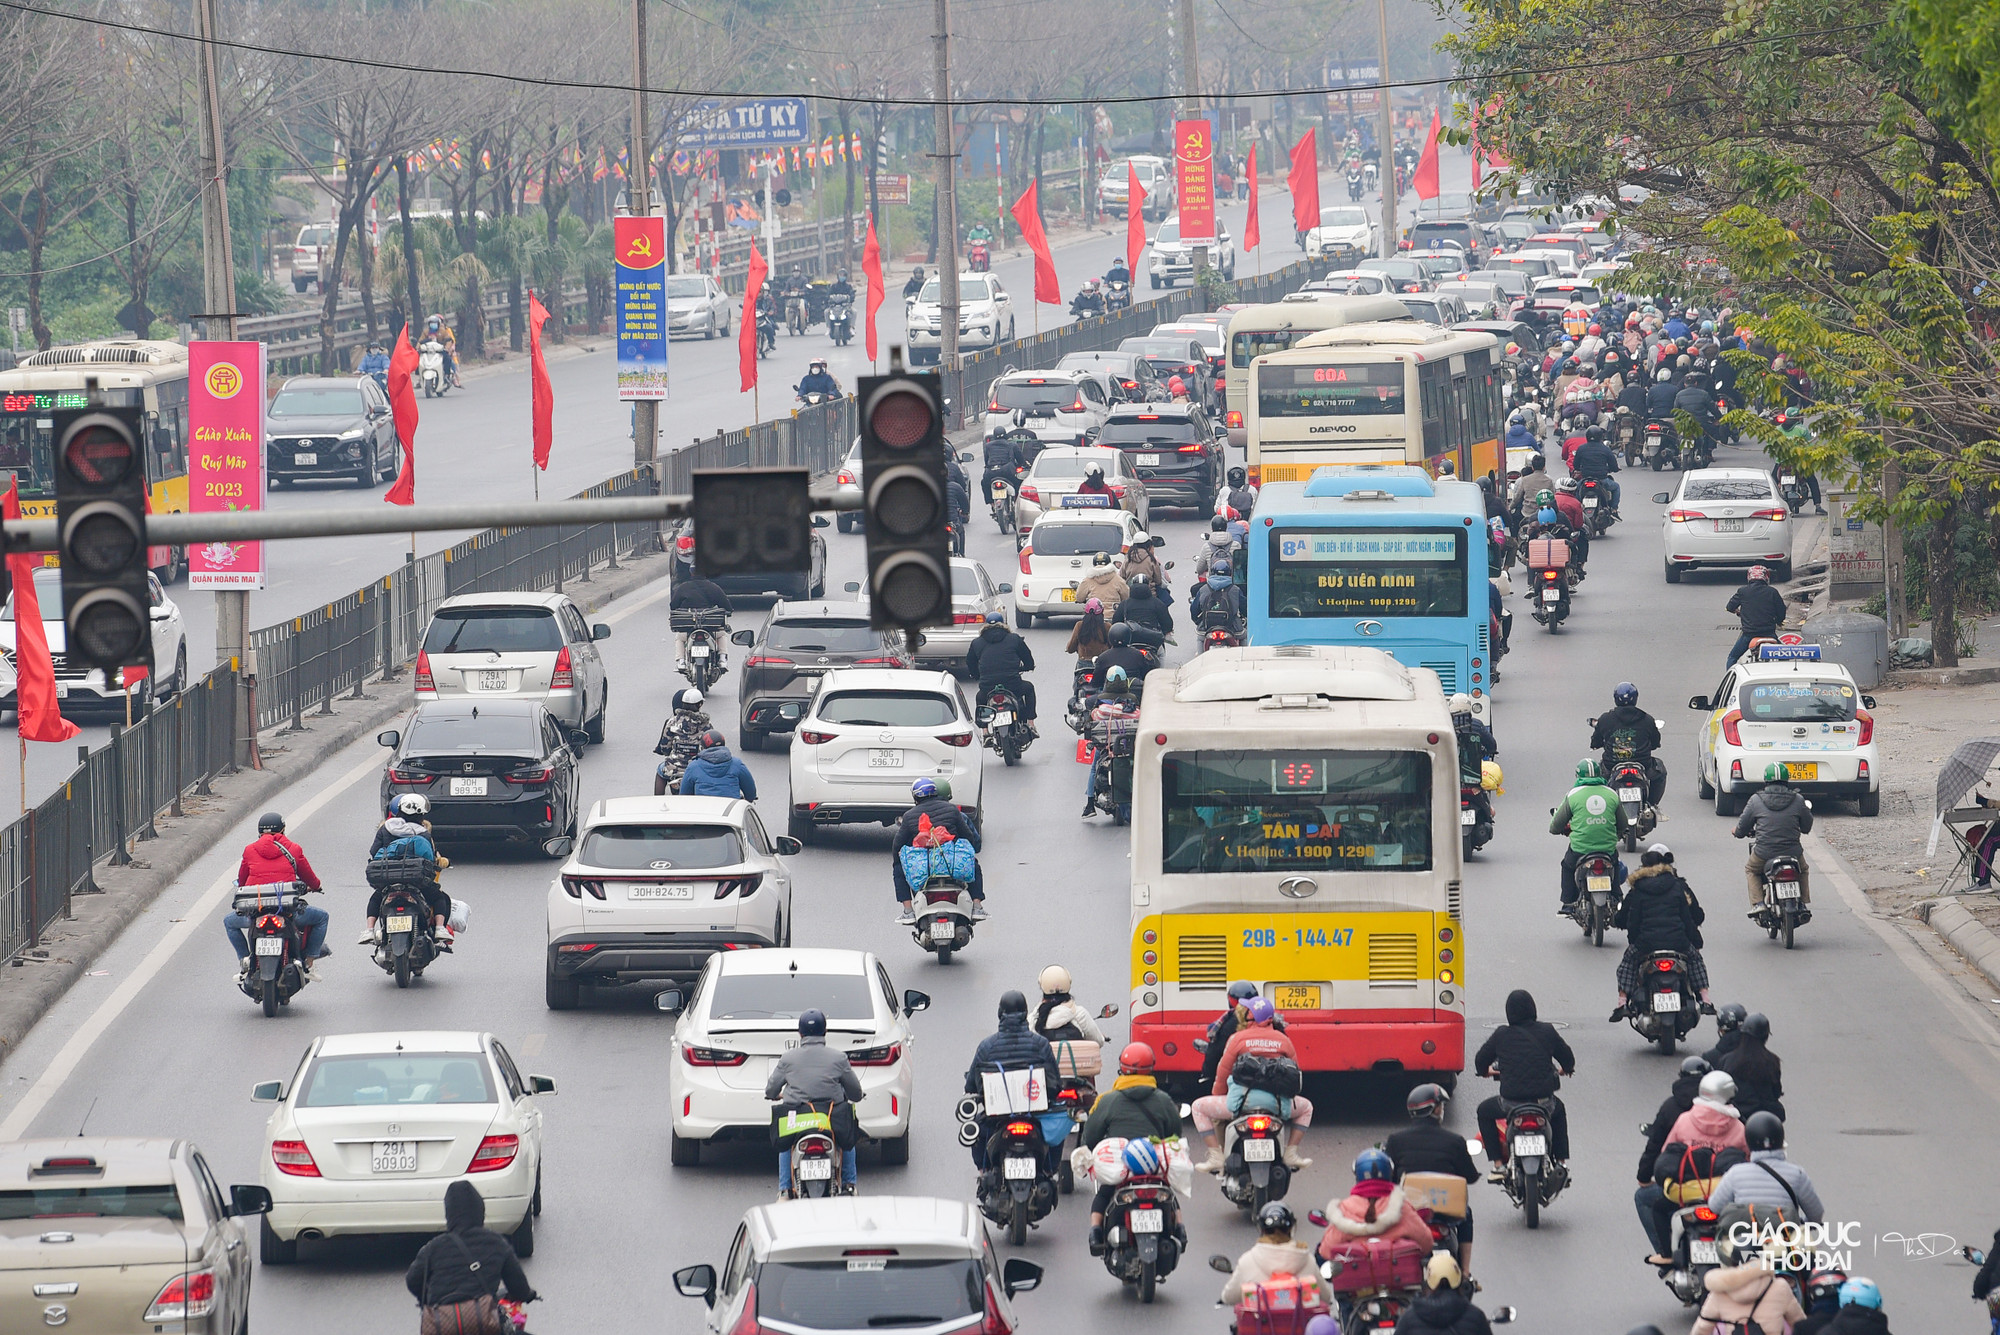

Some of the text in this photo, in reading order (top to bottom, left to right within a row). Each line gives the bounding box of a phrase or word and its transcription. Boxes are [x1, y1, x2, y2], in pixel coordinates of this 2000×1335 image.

[736, 102, 766, 128] TỨ
[770, 101, 799, 127] KỲ
[1186, 150, 1201, 158] 3-2
[1184, 165, 1205, 173] MỪNG
[1185, 174, 1205, 183] ĐẢNG
[1185, 185, 1206, 193] MỪNG
[1186, 195, 1206, 204] XUÂN
[619, 281, 662, 291] MỪNG ĐẤT NƯỚC
[640, 292, 650, 300] MỚI
[625, 301, 656, 310] MỪNG ĐẢNG
[625, 312, 656, 321] QUANG VINH
[625, 321, 657, 330] MỪNG XUÂN
[632, 331, 645, 340] MÃO
[646, 332, 658, 340] 2023
[1313, 368, 1347, 382] 60A
[195, 425, 252, 443] Chào Xuân
[1309, 425, 1357, 434] DAEWOO
[201, 454, 247, 472] Quý Mão
[205, 482, 243, 497] 2023
[1283, 540, 1306, 556] 8A
[192, 574, 256, 585] QUẬN HOÀNG MAI
[1318, 573, 1415, 588] BUS LIÊN NINH
[1326, 598, 1365, 606] Hotline
[485, 672, 500, 680] 29A
[481, 681, 506, 689] 142.02
[454, 786, 483, 794] 989.35
[1262, 821, 1300, 839] TÂN
[1237, 845, 1286, 858] Hotline
[1295, 845, 1332, 858] 1900
[1242, 928, 1354, 947] 29B 144.47
[1287, 986, 1307, 997] 29B
[1280, 997, 1316, 1008] 144.47
[1245, 1039, 1282, 1048] BURBERRY
[383, 1142, 405, 1155] 29A
[374, 1156, 415, 1170] 309.03
